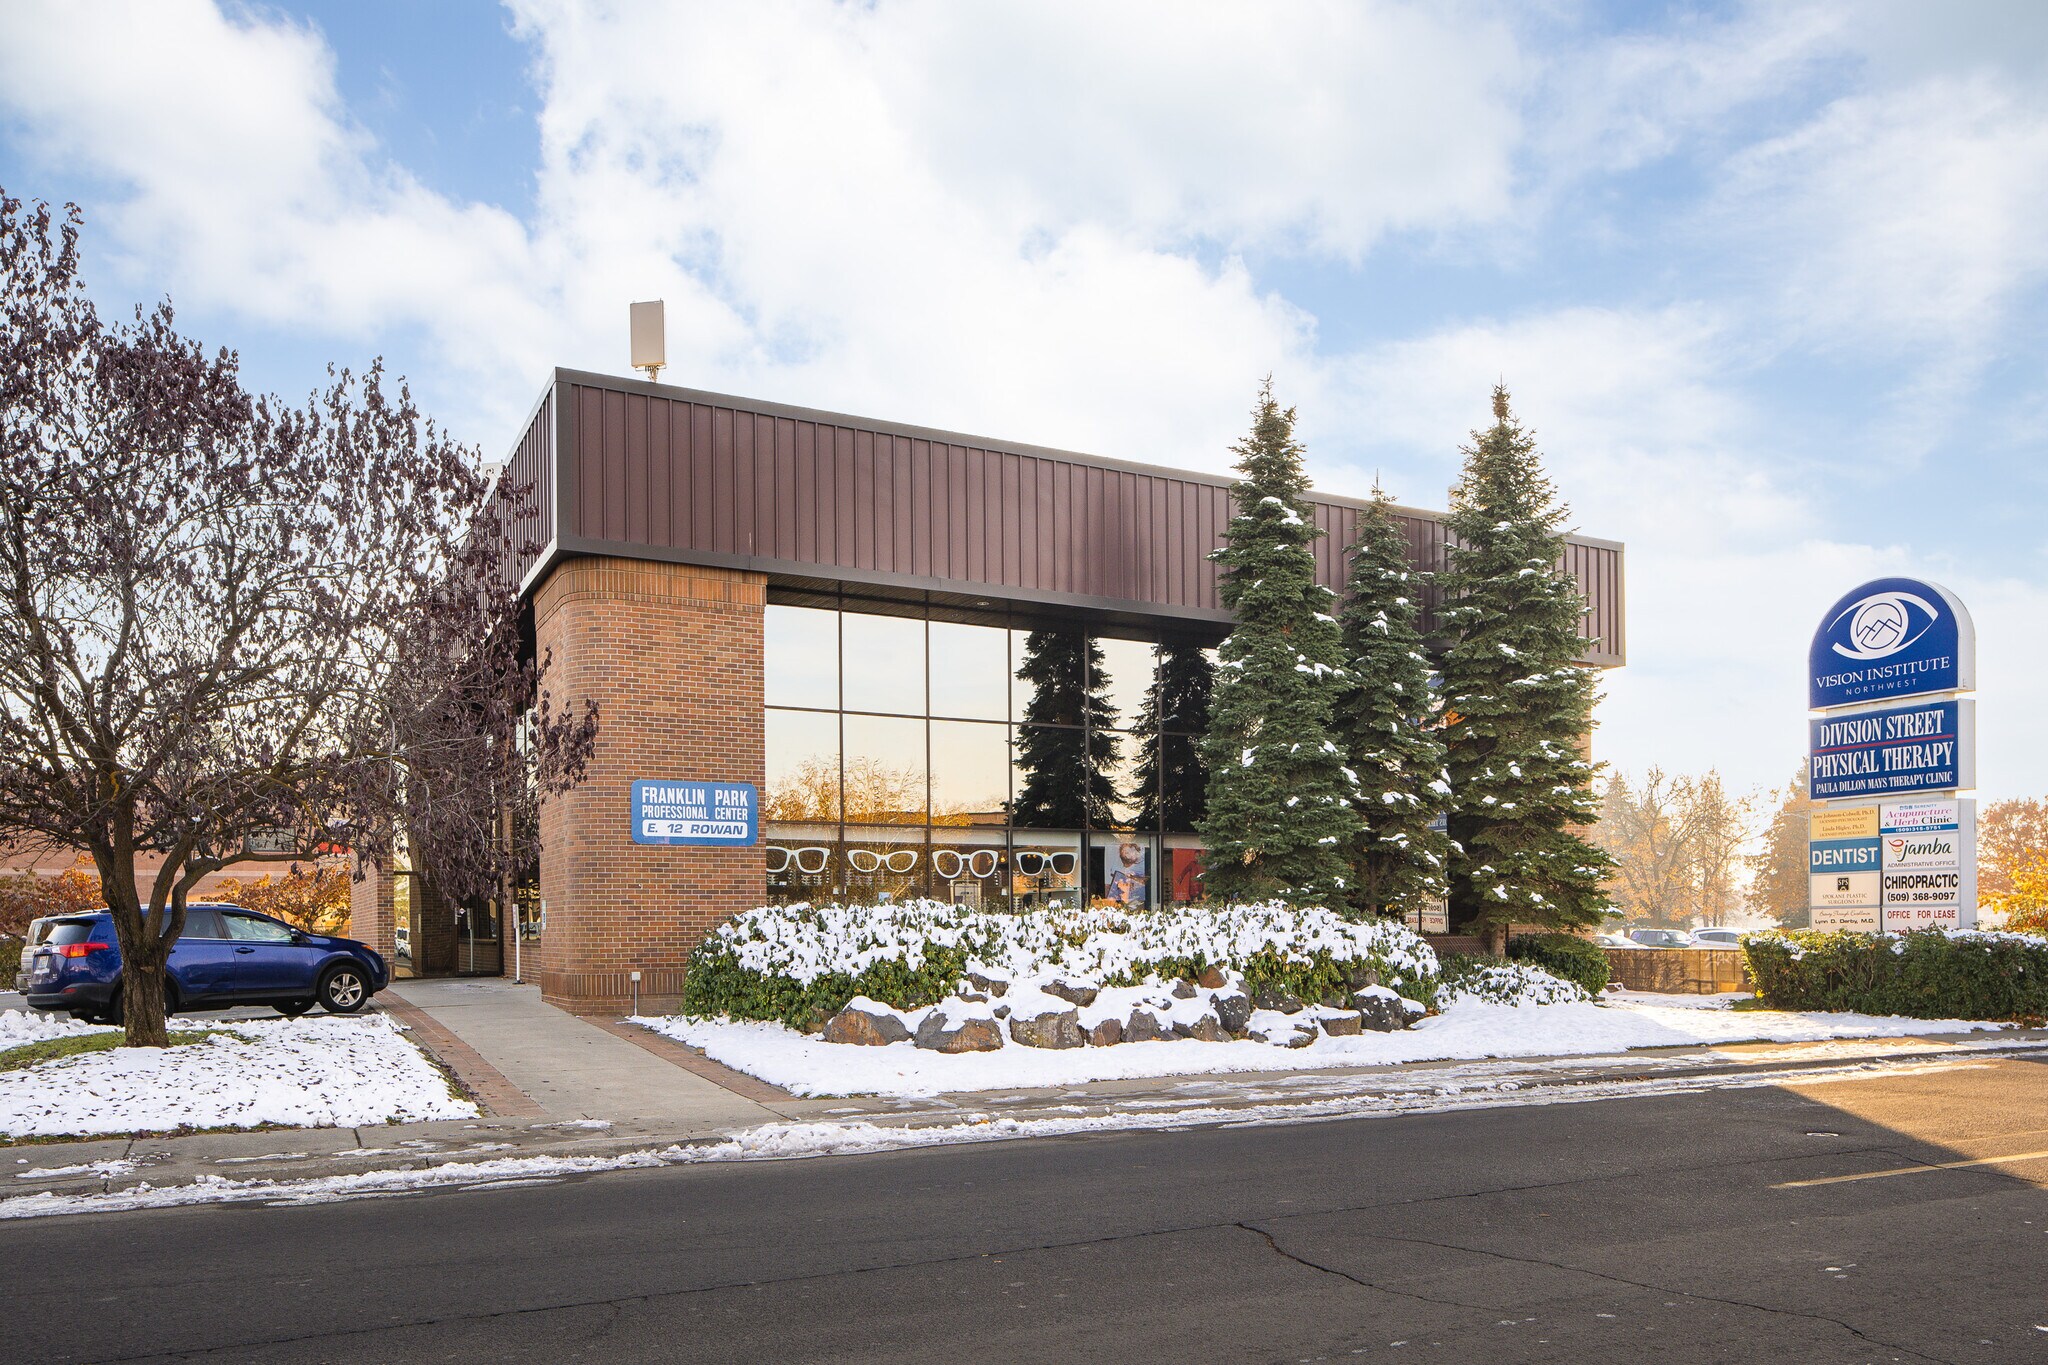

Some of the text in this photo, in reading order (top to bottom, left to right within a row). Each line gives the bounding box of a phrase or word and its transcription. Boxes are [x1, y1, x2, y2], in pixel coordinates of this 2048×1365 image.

[1816, 656, 1950, 688] VISION INSTITUTE
[1846, 678, 1917, 695] NORTHWEST
[1820, 709, 1945, 748] DIVISION STREET
[1813, 741, 1954, 778] PHYSICAL THERAPY
[1815, 771, 1953, 794] PAULA DILLON MAYS THERAPY CLINIC
[642, 786, 749, 807] FRANKLIN PARK
[642, 805, 748, 820] PROFESSIONAL CENTER
[1886, 808, 1952, 819] Acupuncture
[1894, 818, 1918, 826] Herb
[1921, 815, 1952, 824] Clinic
[647, 823, 743, 835] E. 12 ROWAN
[1812, 846, 1878, 866] DENTIST
[1897, 837, 1952, 862] jamba
[1885, 873, 1958, 890] CHIROPRACTIC
[1887, 892, 1955, 902] (509) 368-9097
[1887, 909, 1956, 919] OFFICE FOR LEASE
